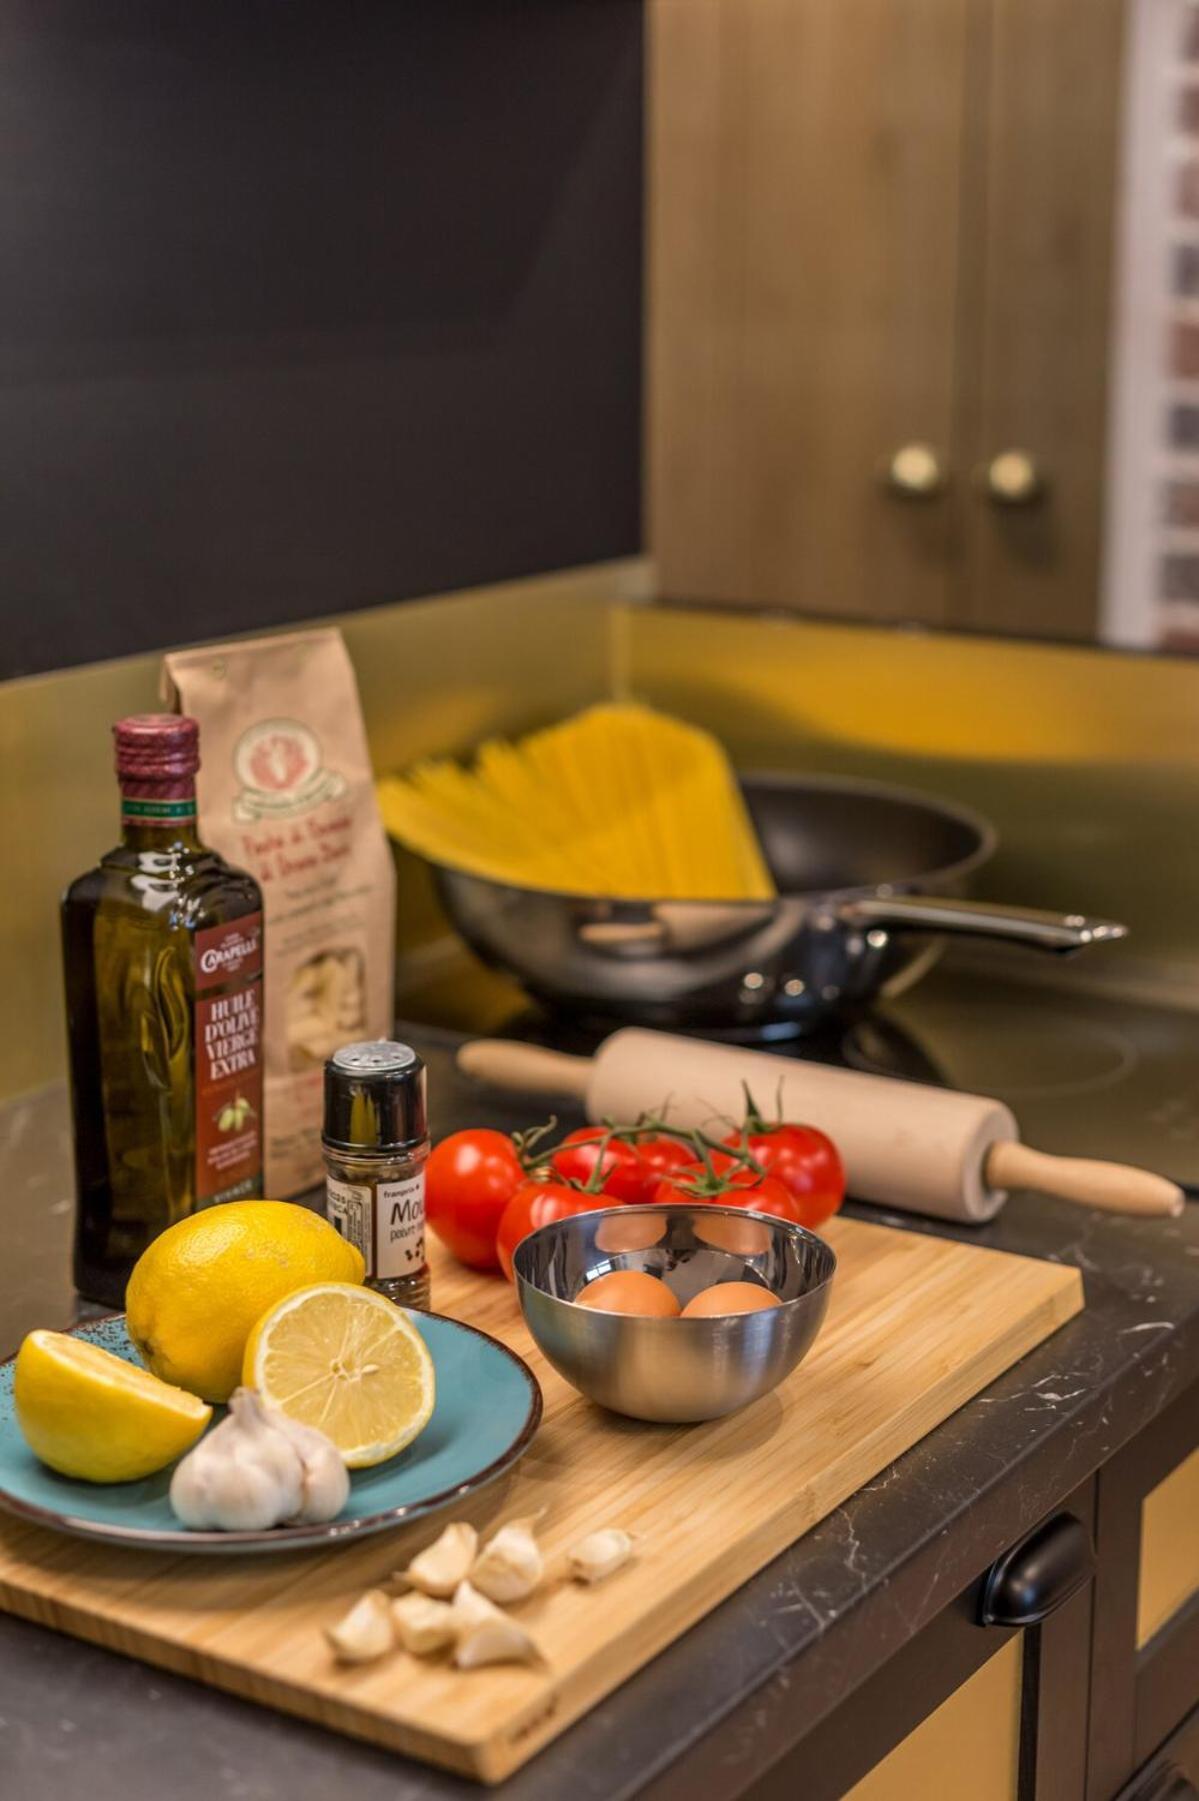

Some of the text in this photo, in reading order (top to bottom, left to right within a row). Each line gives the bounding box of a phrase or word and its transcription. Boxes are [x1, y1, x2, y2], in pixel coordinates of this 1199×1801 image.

[211, 990, 255, 1021] HUILE
[206, 1027, 256, 1061] VIERGE
[210, 1048, 256, 1080] EXTRA
